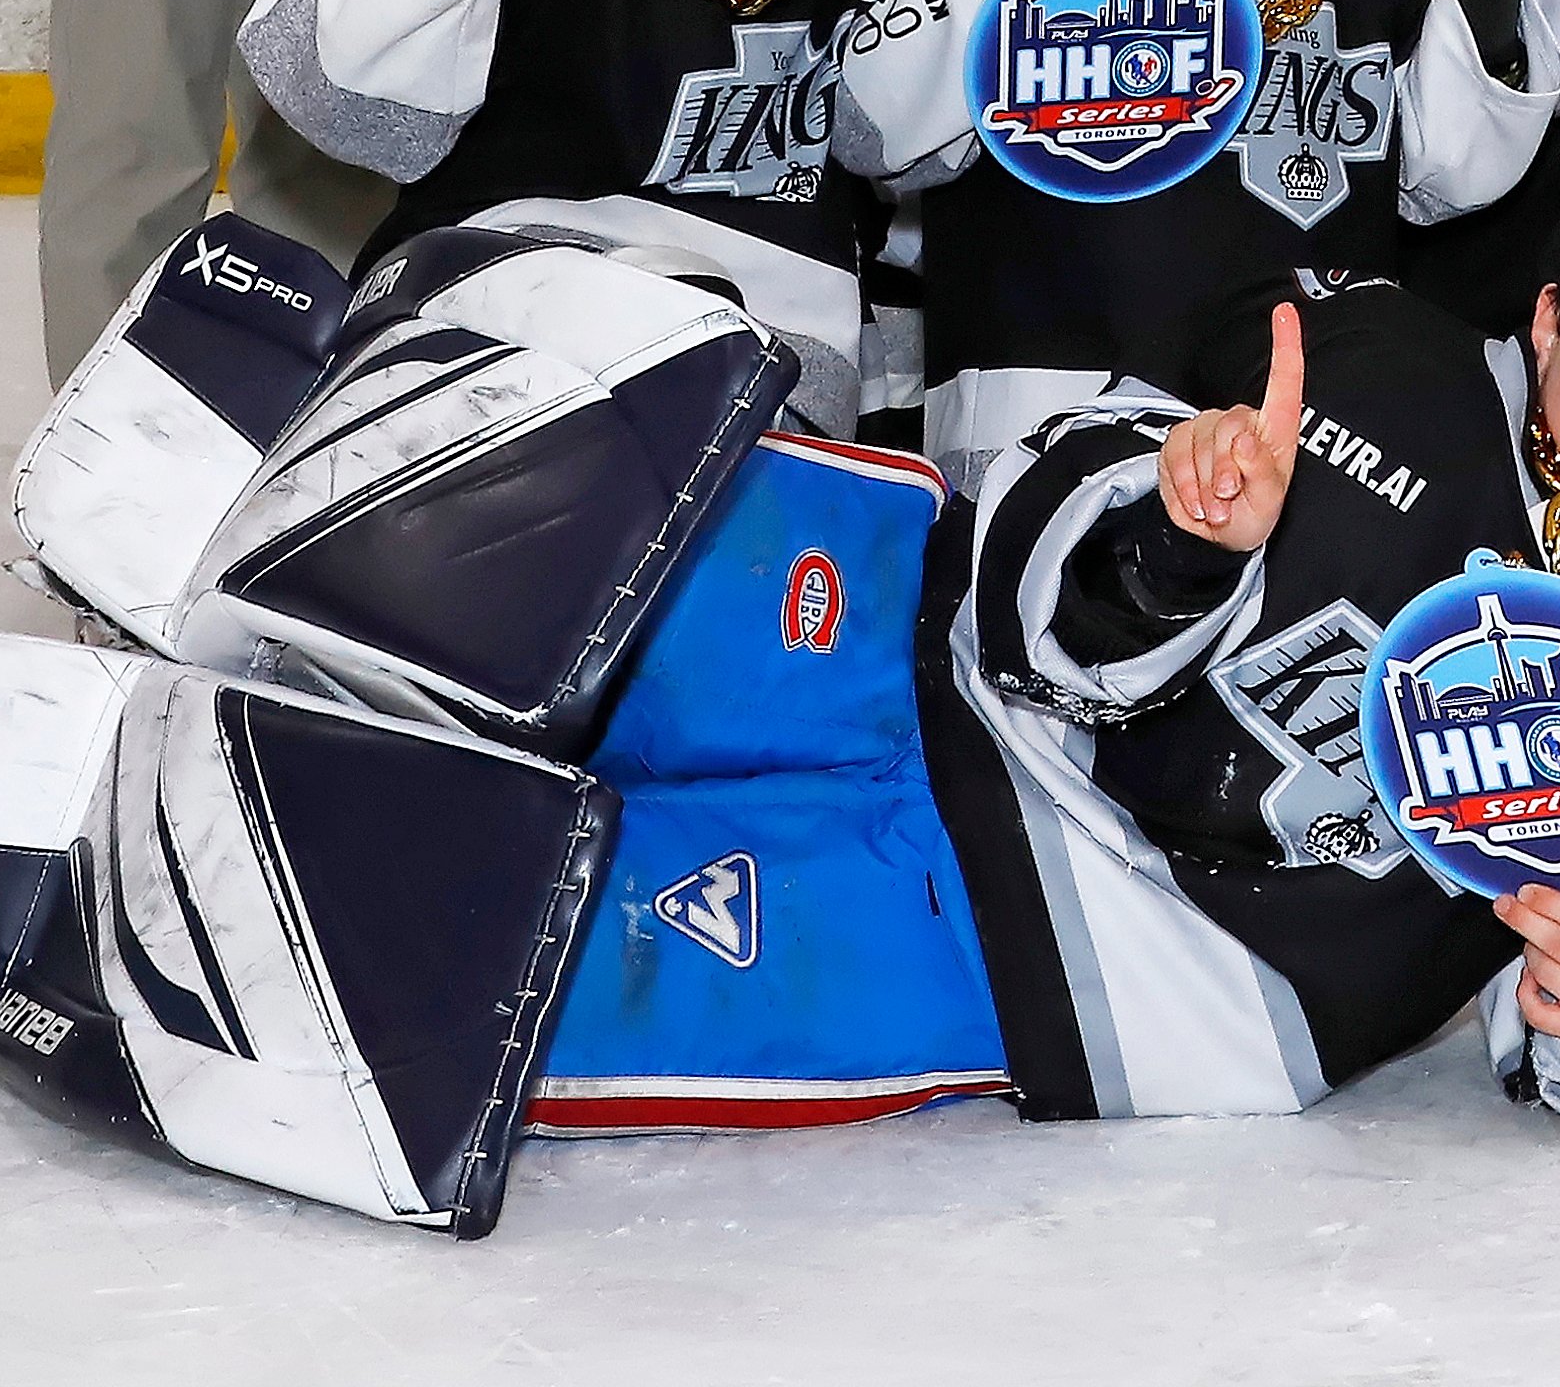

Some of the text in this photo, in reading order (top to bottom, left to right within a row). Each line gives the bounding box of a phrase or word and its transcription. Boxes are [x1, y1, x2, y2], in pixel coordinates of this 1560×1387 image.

[1015, 37, 1208, 104] HHOF
[1241, 48, 1386, 145] INGS
[1074, 127, 1148, 139] TORONTO
[179, 233, 313, 311] X5 PRO
[1298, 404, 1427, 513] LEVR.AI
[1448, 706, 1489, 719] PLAY
